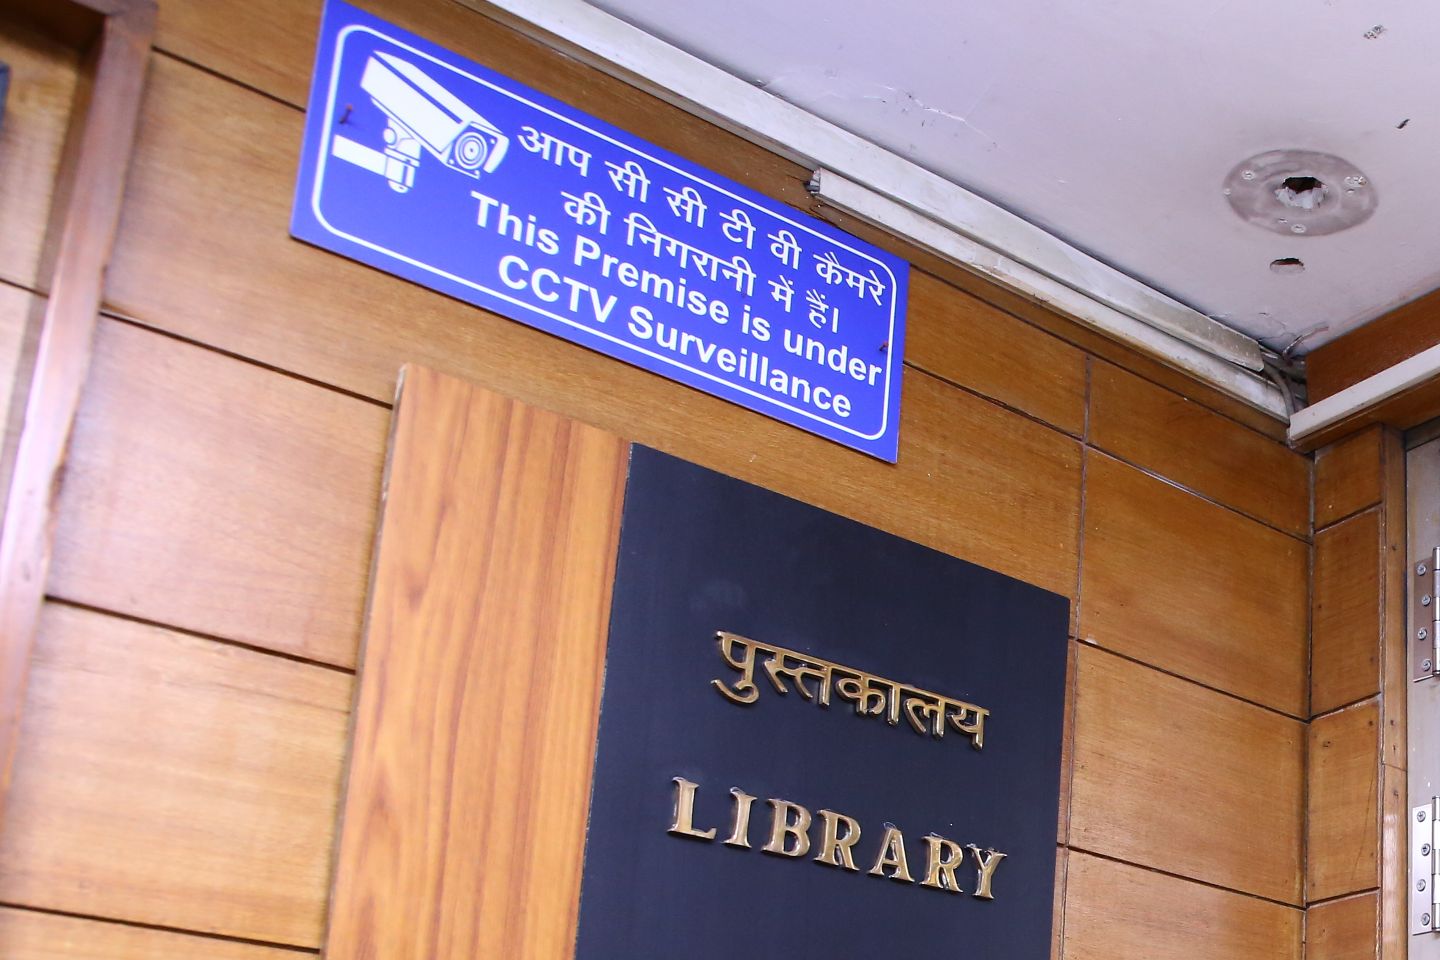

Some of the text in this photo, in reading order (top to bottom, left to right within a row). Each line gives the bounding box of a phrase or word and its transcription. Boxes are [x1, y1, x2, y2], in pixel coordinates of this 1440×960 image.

[517, 125, 885, 306] आप सी सी टी वी कैमरे
[561, 191, 610, 235] की
[625, 211, 756, 296] निगरानी
[768, 275, 794, 313] में
[471, 190, 883, 387] This Premise is under
[497, 254, 852, 419] CCTV Surveillance
[711, 630, 990, 750] पुस्तकालय
[667, 776, 1007, 900] LIBRARY
